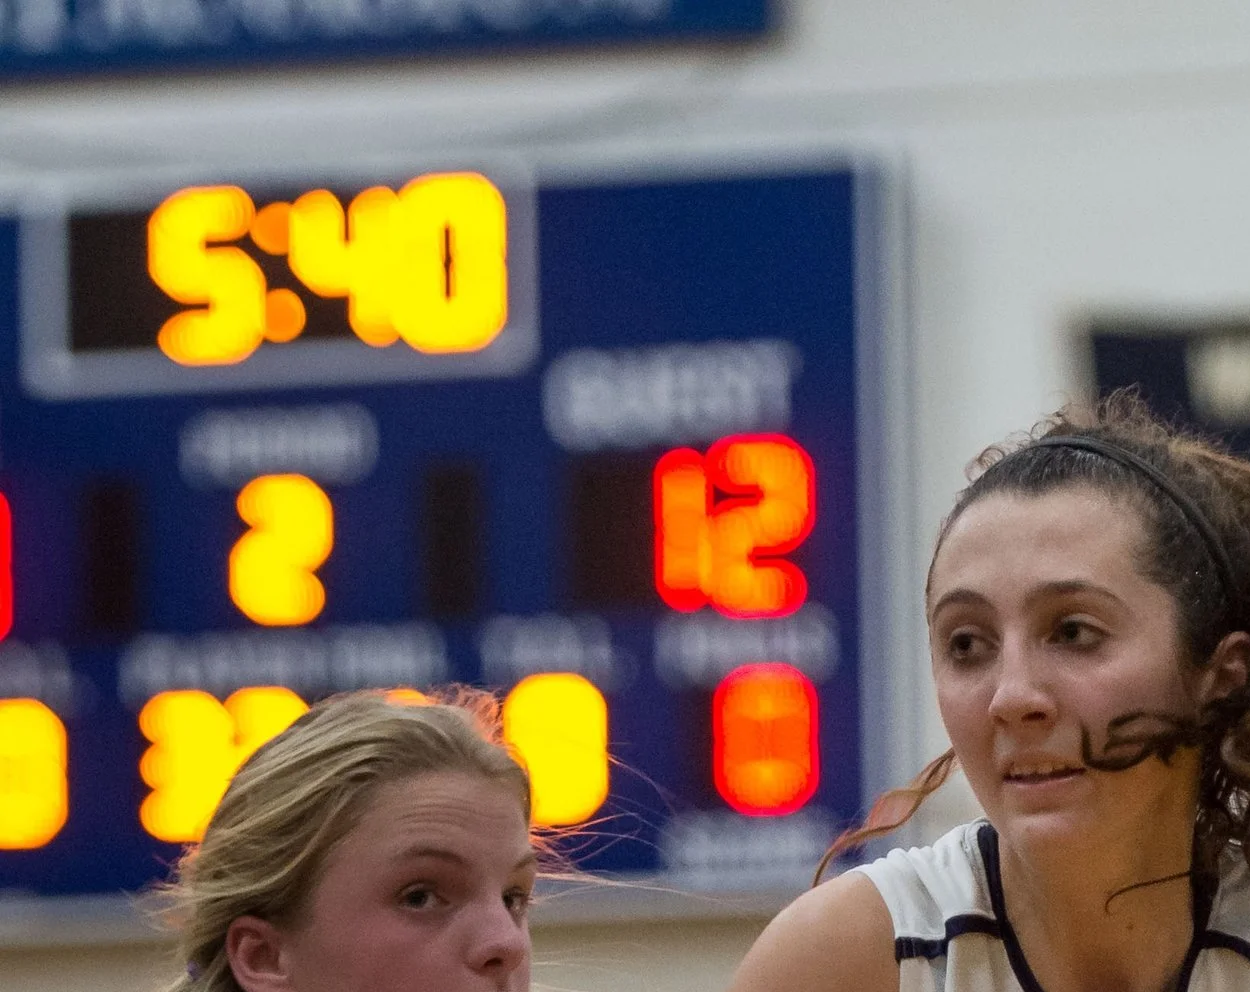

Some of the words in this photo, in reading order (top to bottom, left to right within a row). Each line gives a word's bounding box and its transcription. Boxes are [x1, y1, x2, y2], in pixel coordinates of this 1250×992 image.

[147, 172, 508, 367] 5:40
[229, 473, 334, 626] 2
[653, 432, 817, 620] 12
